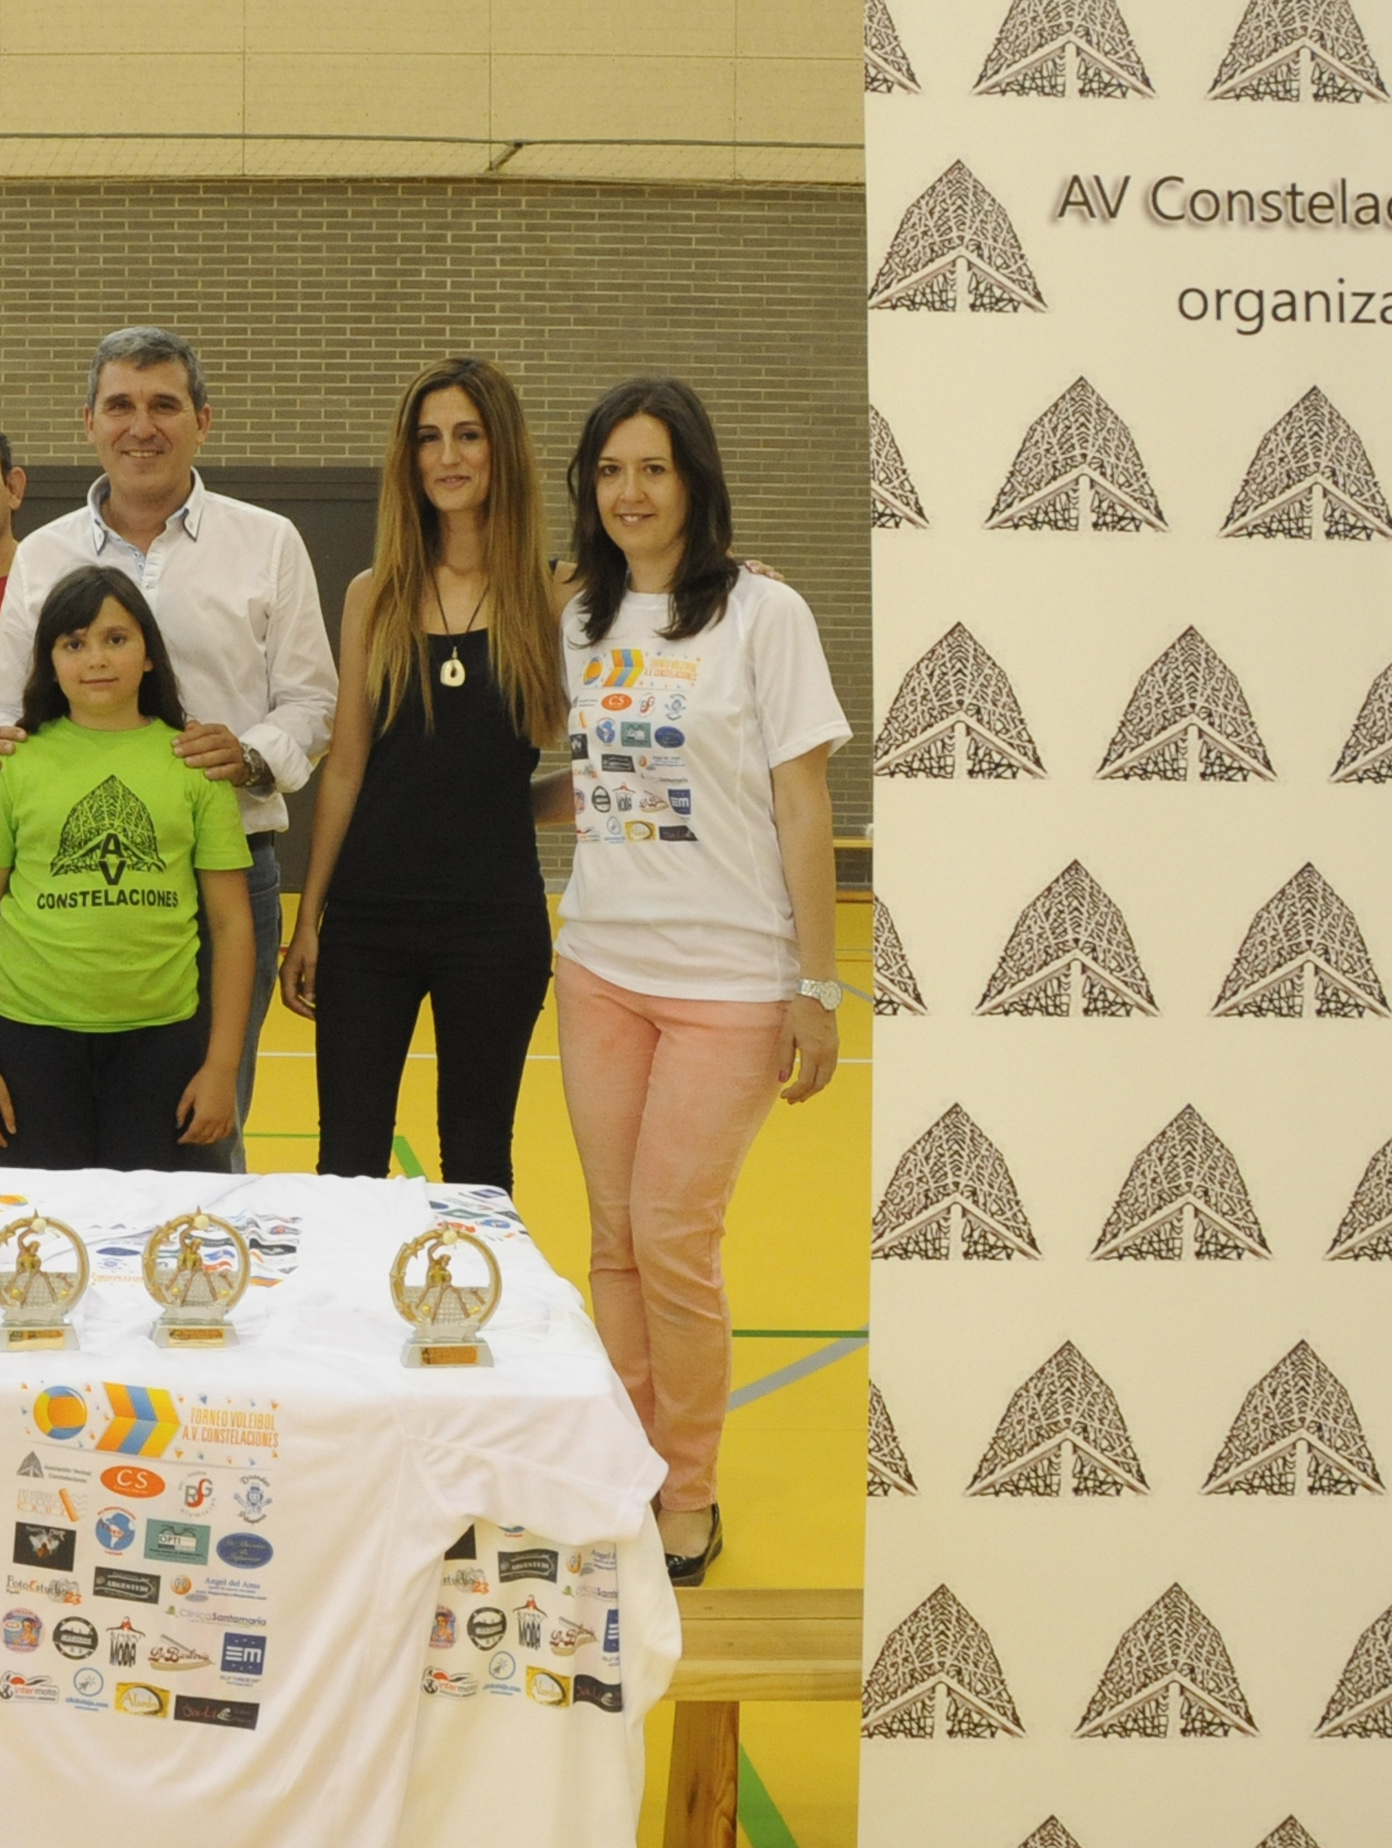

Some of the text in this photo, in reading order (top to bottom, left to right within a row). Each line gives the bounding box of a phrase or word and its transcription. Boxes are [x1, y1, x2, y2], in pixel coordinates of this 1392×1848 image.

[1056, 174, 1392, 226] AV Constela
[37, 888, 179, 910] CONSTELACIONES
[190, 1407, 276, 1431] TORNEO VOLEIBOL
[181, 1424, 280, 1449] A.V. CONSTELACIONES
[116, 1469, 149, 1489] CS
[62, 1591, 82, 1606] 23
